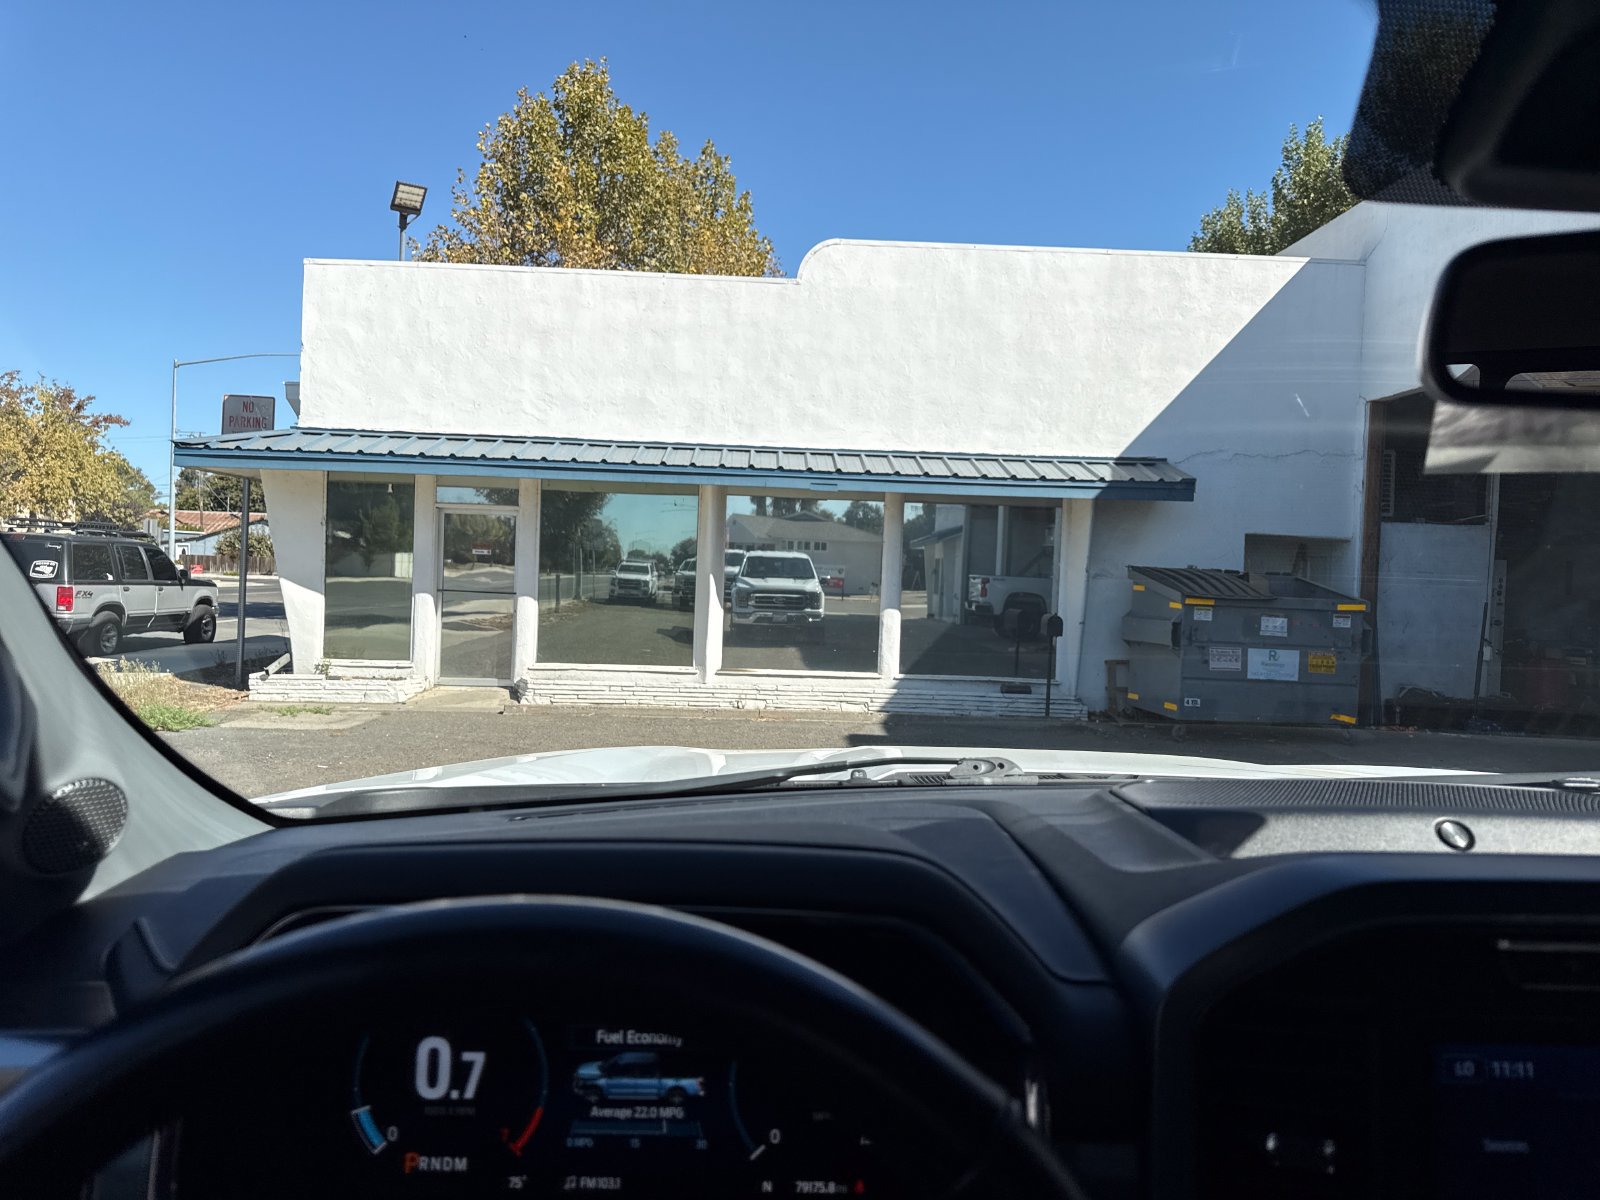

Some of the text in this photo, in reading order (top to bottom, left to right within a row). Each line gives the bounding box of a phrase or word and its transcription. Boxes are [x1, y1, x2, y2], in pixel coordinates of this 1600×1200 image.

[242, 400, 255, 413] NO
[228, 415, 267, 429] PARKING
[596, 1029, 684, 1048] Fuel Economy
[414, 1036, 486, 1101] 0.7
[590, 1105, 684, 1120] Average 22.0 MPG
[385, 1124, 399, 1143] 0
[769, 1127, 782, 1145] 0
[761, 1180, 773, 1193] N
